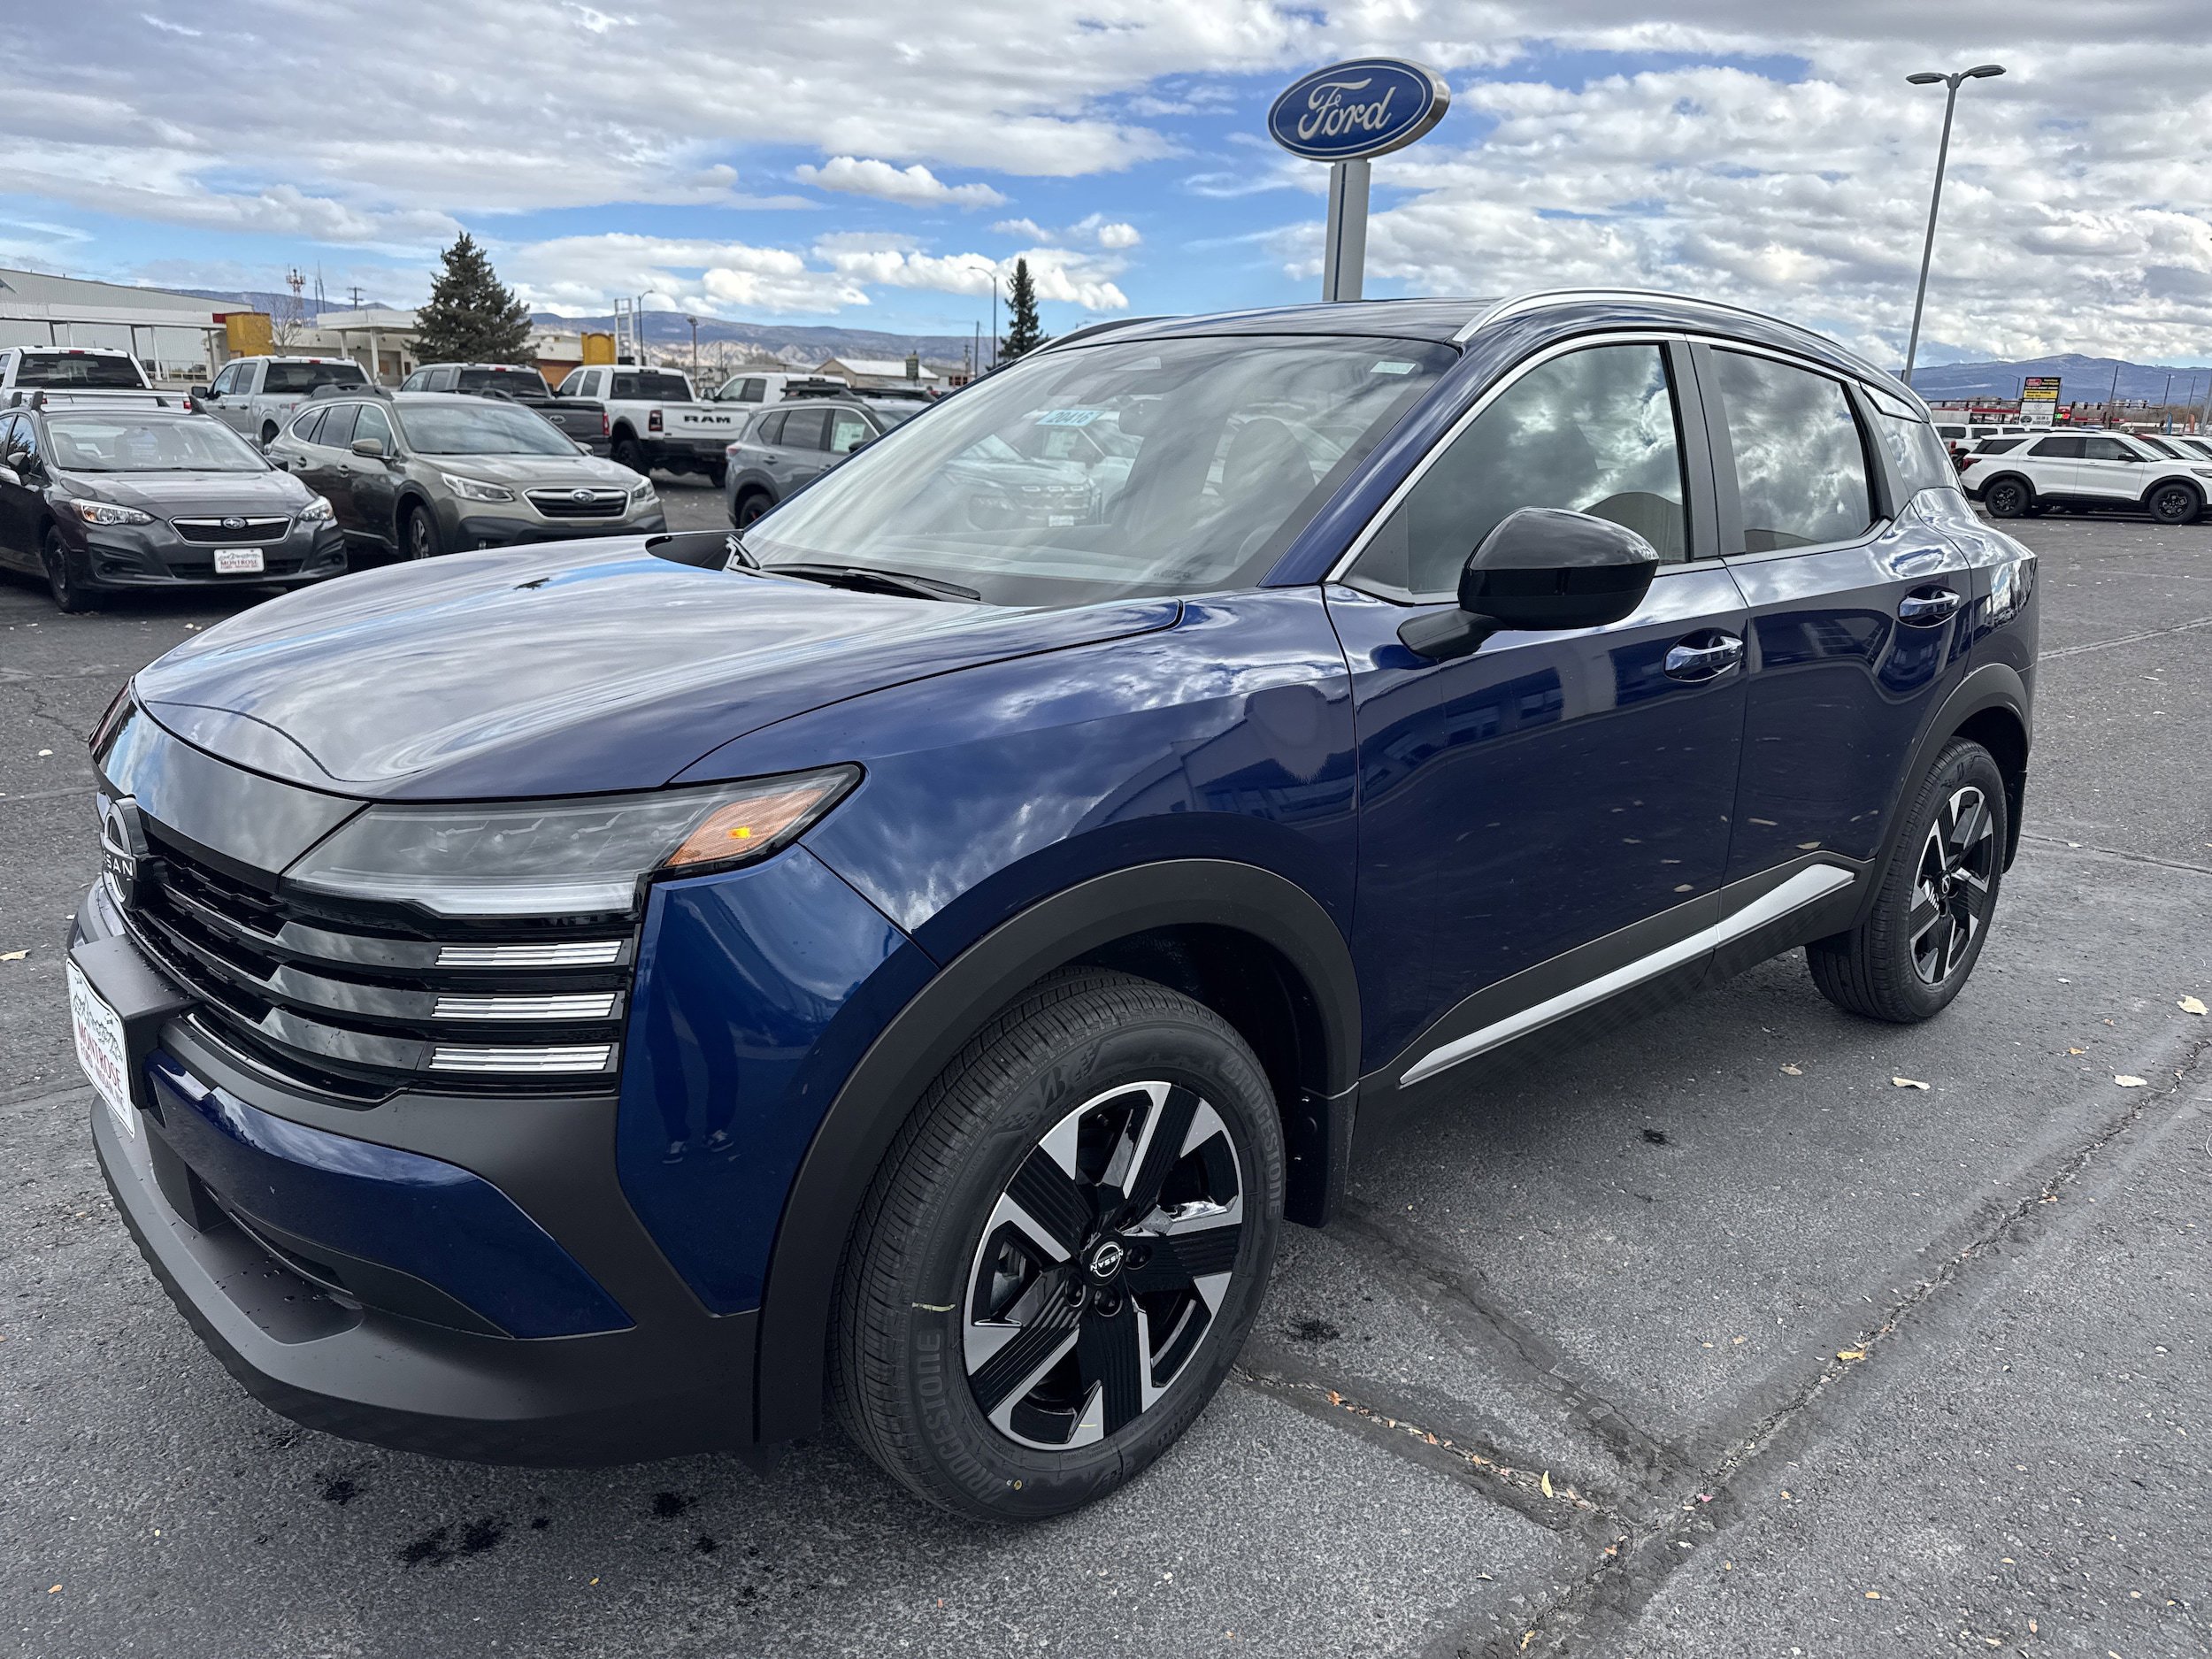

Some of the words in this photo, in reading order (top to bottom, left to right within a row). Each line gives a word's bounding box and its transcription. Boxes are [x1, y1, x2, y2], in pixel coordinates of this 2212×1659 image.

[1298, 77, 1396, 141] Ford
[1046, 411, 1094, 424] 20416
[77, 1017, 123, 1094] MONTROSE
[1218, 1056, 1283, 1217] BRIDGESTONE
[1090, 1248, 1124, 1271] NISSAN
[917, 1333, 1009, 1504] BRIDGESTONE
